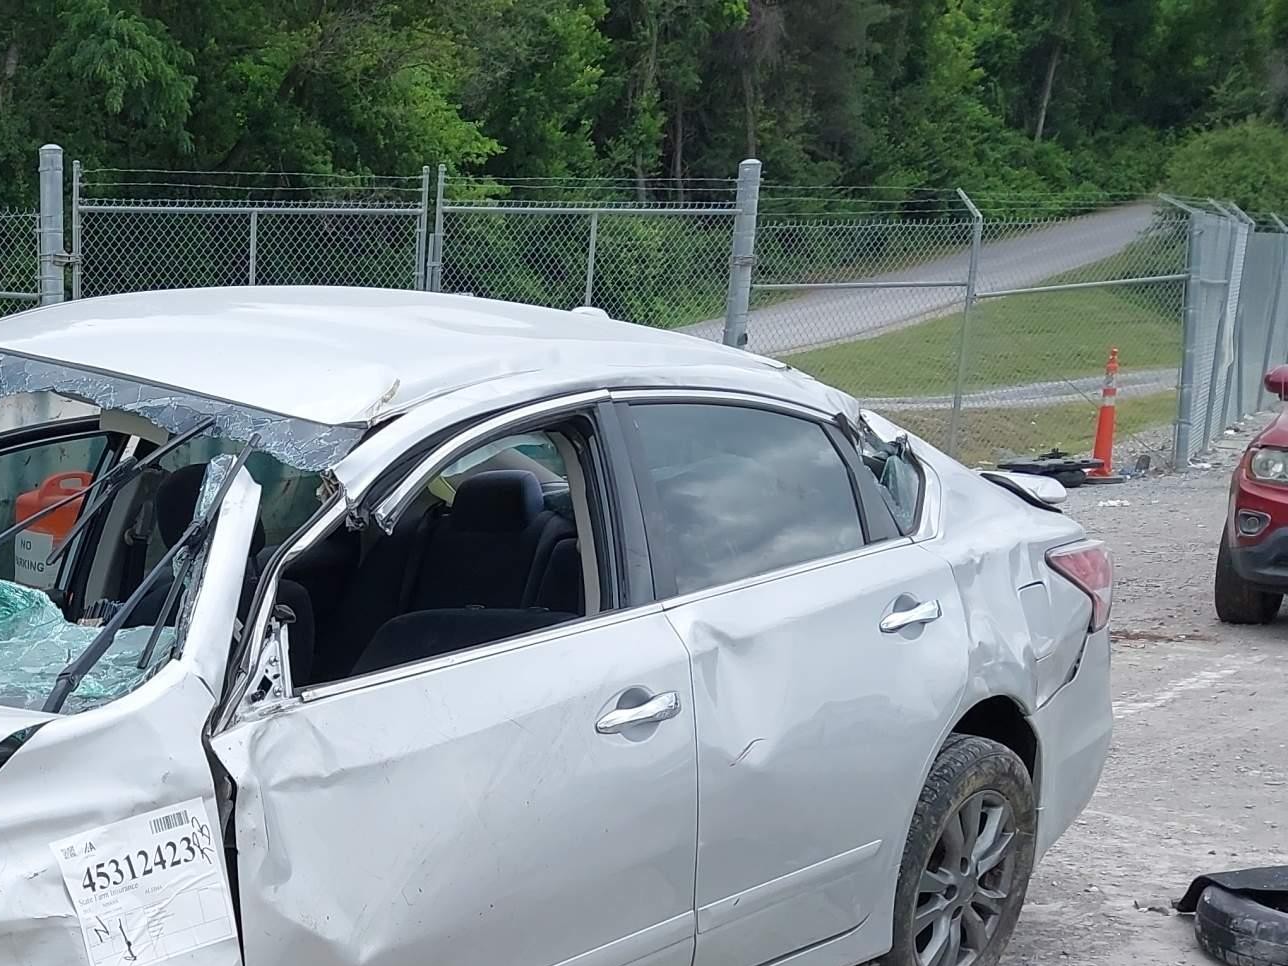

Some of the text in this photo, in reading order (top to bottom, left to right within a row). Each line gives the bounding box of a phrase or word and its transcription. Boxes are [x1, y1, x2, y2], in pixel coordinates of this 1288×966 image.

[20, 538, 32, 551] NO
[16, 555, 45, 573] ARKING
[82, 836, 196, 892] 45312423
[78, 896, 93, 906] State
[110, 883, 139, 898] Insurance
